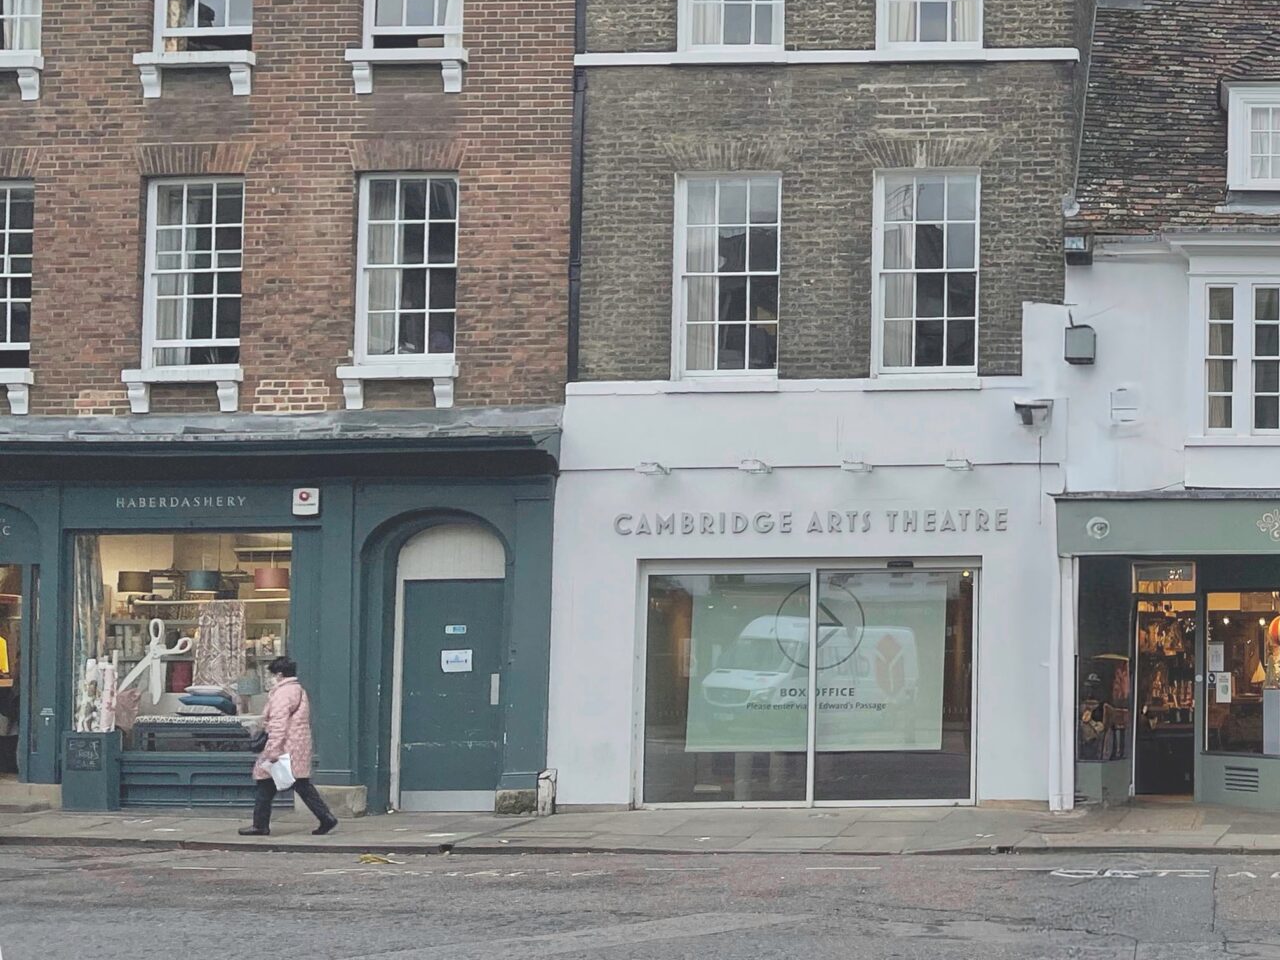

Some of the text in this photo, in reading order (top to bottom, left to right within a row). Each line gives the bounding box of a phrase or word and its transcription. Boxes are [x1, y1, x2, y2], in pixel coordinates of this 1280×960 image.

[115, 495, 247, 509] HABERDASHERY
[613, 508, 1009, 536] CAMBRIDGE ARTS THEATRE
[779, 687, 806, 697] BOX
[746, 702, 772, 710] Please
[795, 702, 808, 710] via
[855, 701, 887, 712] Passage
